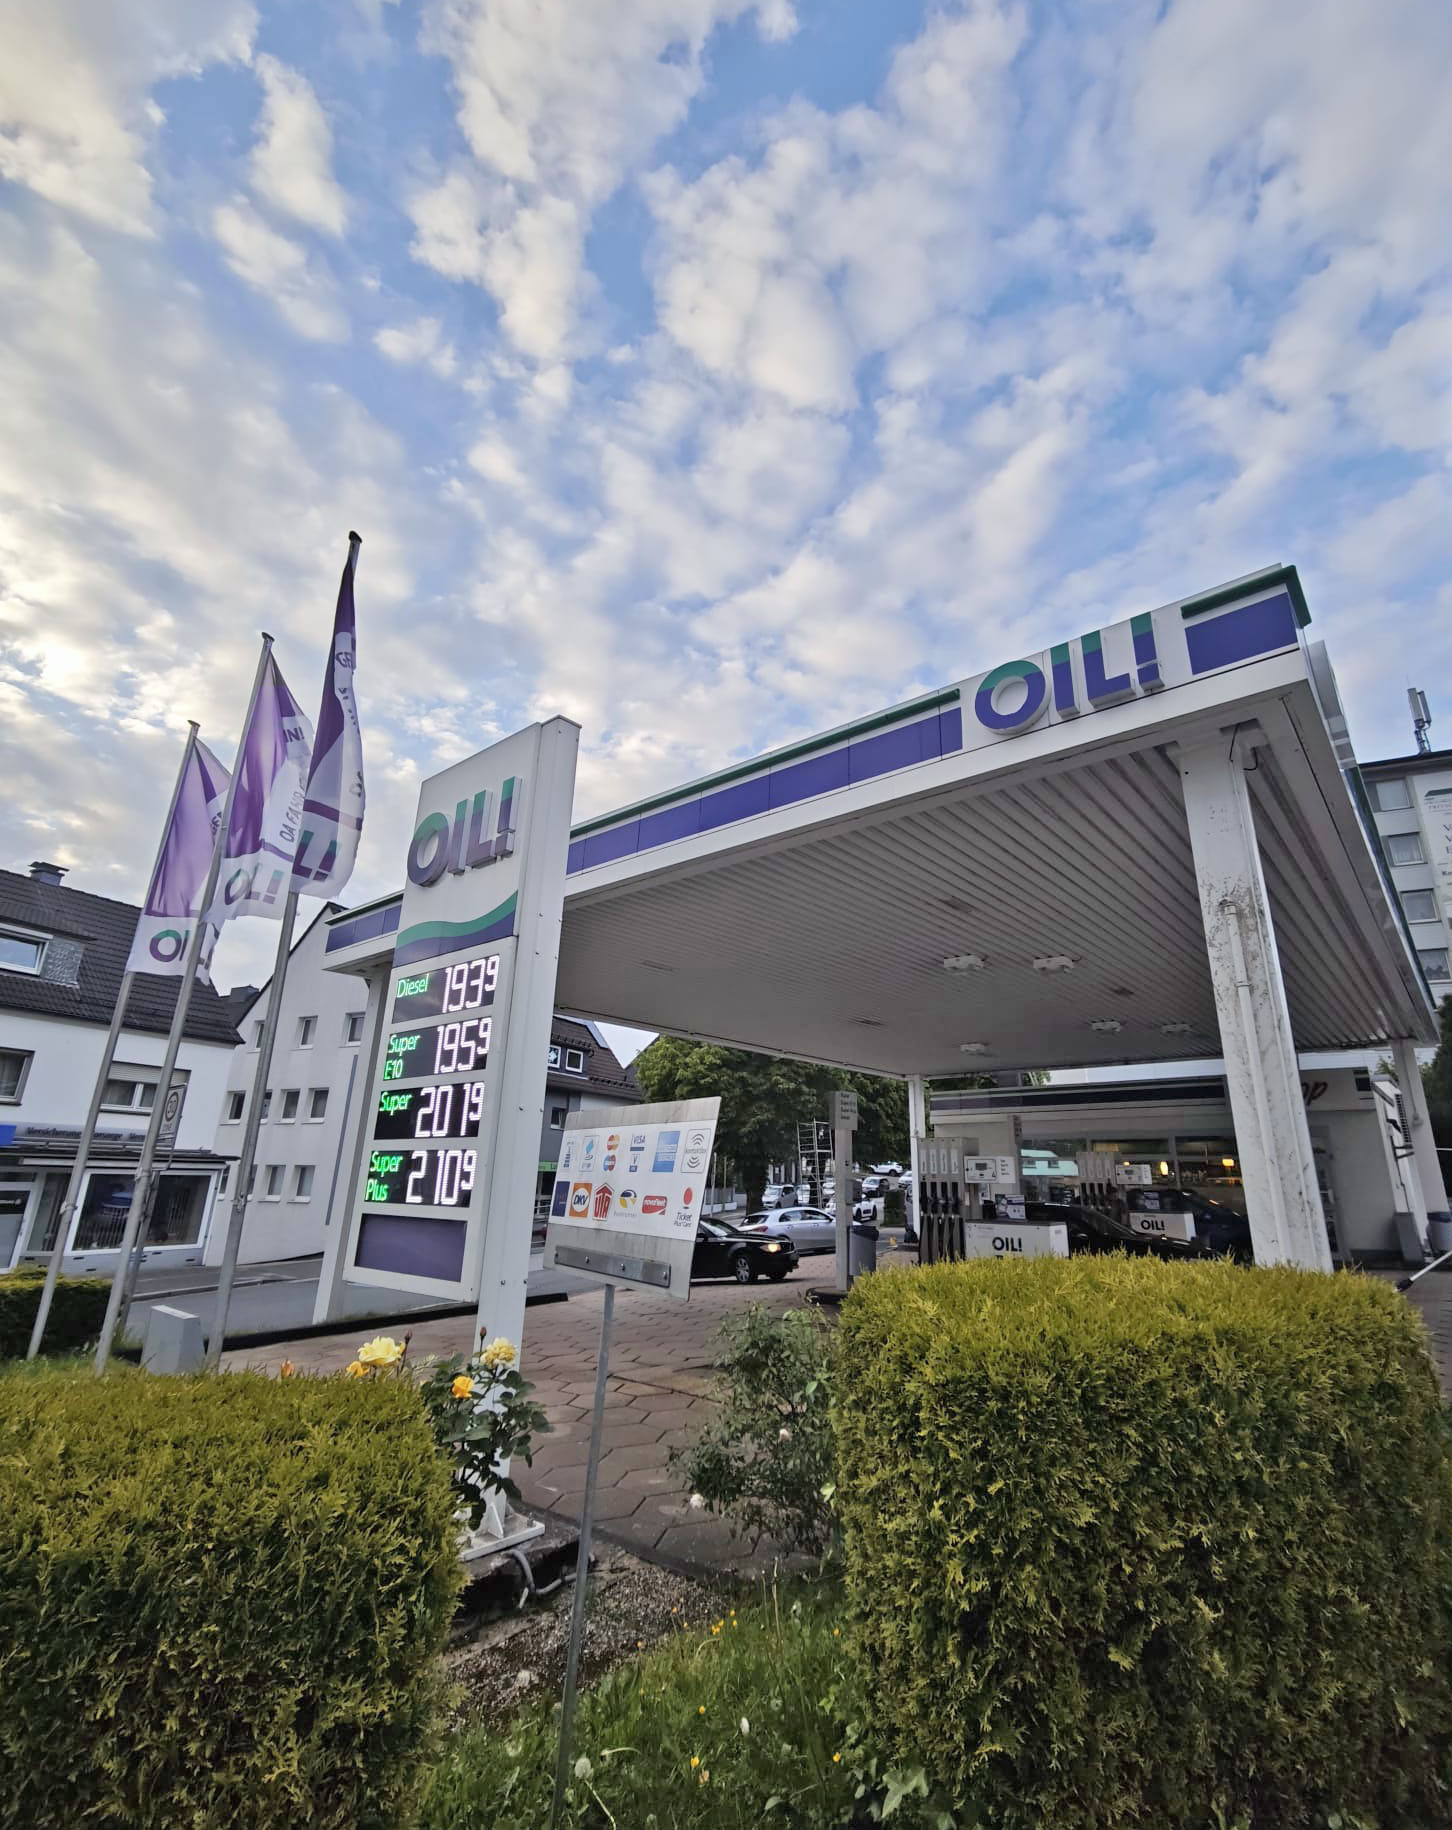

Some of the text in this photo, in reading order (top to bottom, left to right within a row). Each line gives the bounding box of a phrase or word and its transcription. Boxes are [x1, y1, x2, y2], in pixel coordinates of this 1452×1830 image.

[974, 611, 1165, 734] OIL!
[407, 776, 520, 888] OIL!
[396, 974, 430, 998] Diesel
[388, 1034, 421, 1056] Super
[384, 1060, 403, 1080] E10
[379, 1091, 412, 1116] Super
[633, 1134, 646, 1144] VISA
[370, 1152, 403, 1177] Super
[365, 1179, 388, 1201] Plus
[573, 1195, 589, 1206] DKV
[593, 1194, 612, 1220] UTA
[1141, 1219, 1165, 1231] OIL!
[992, 1237, 1022, 1252] OIL!
